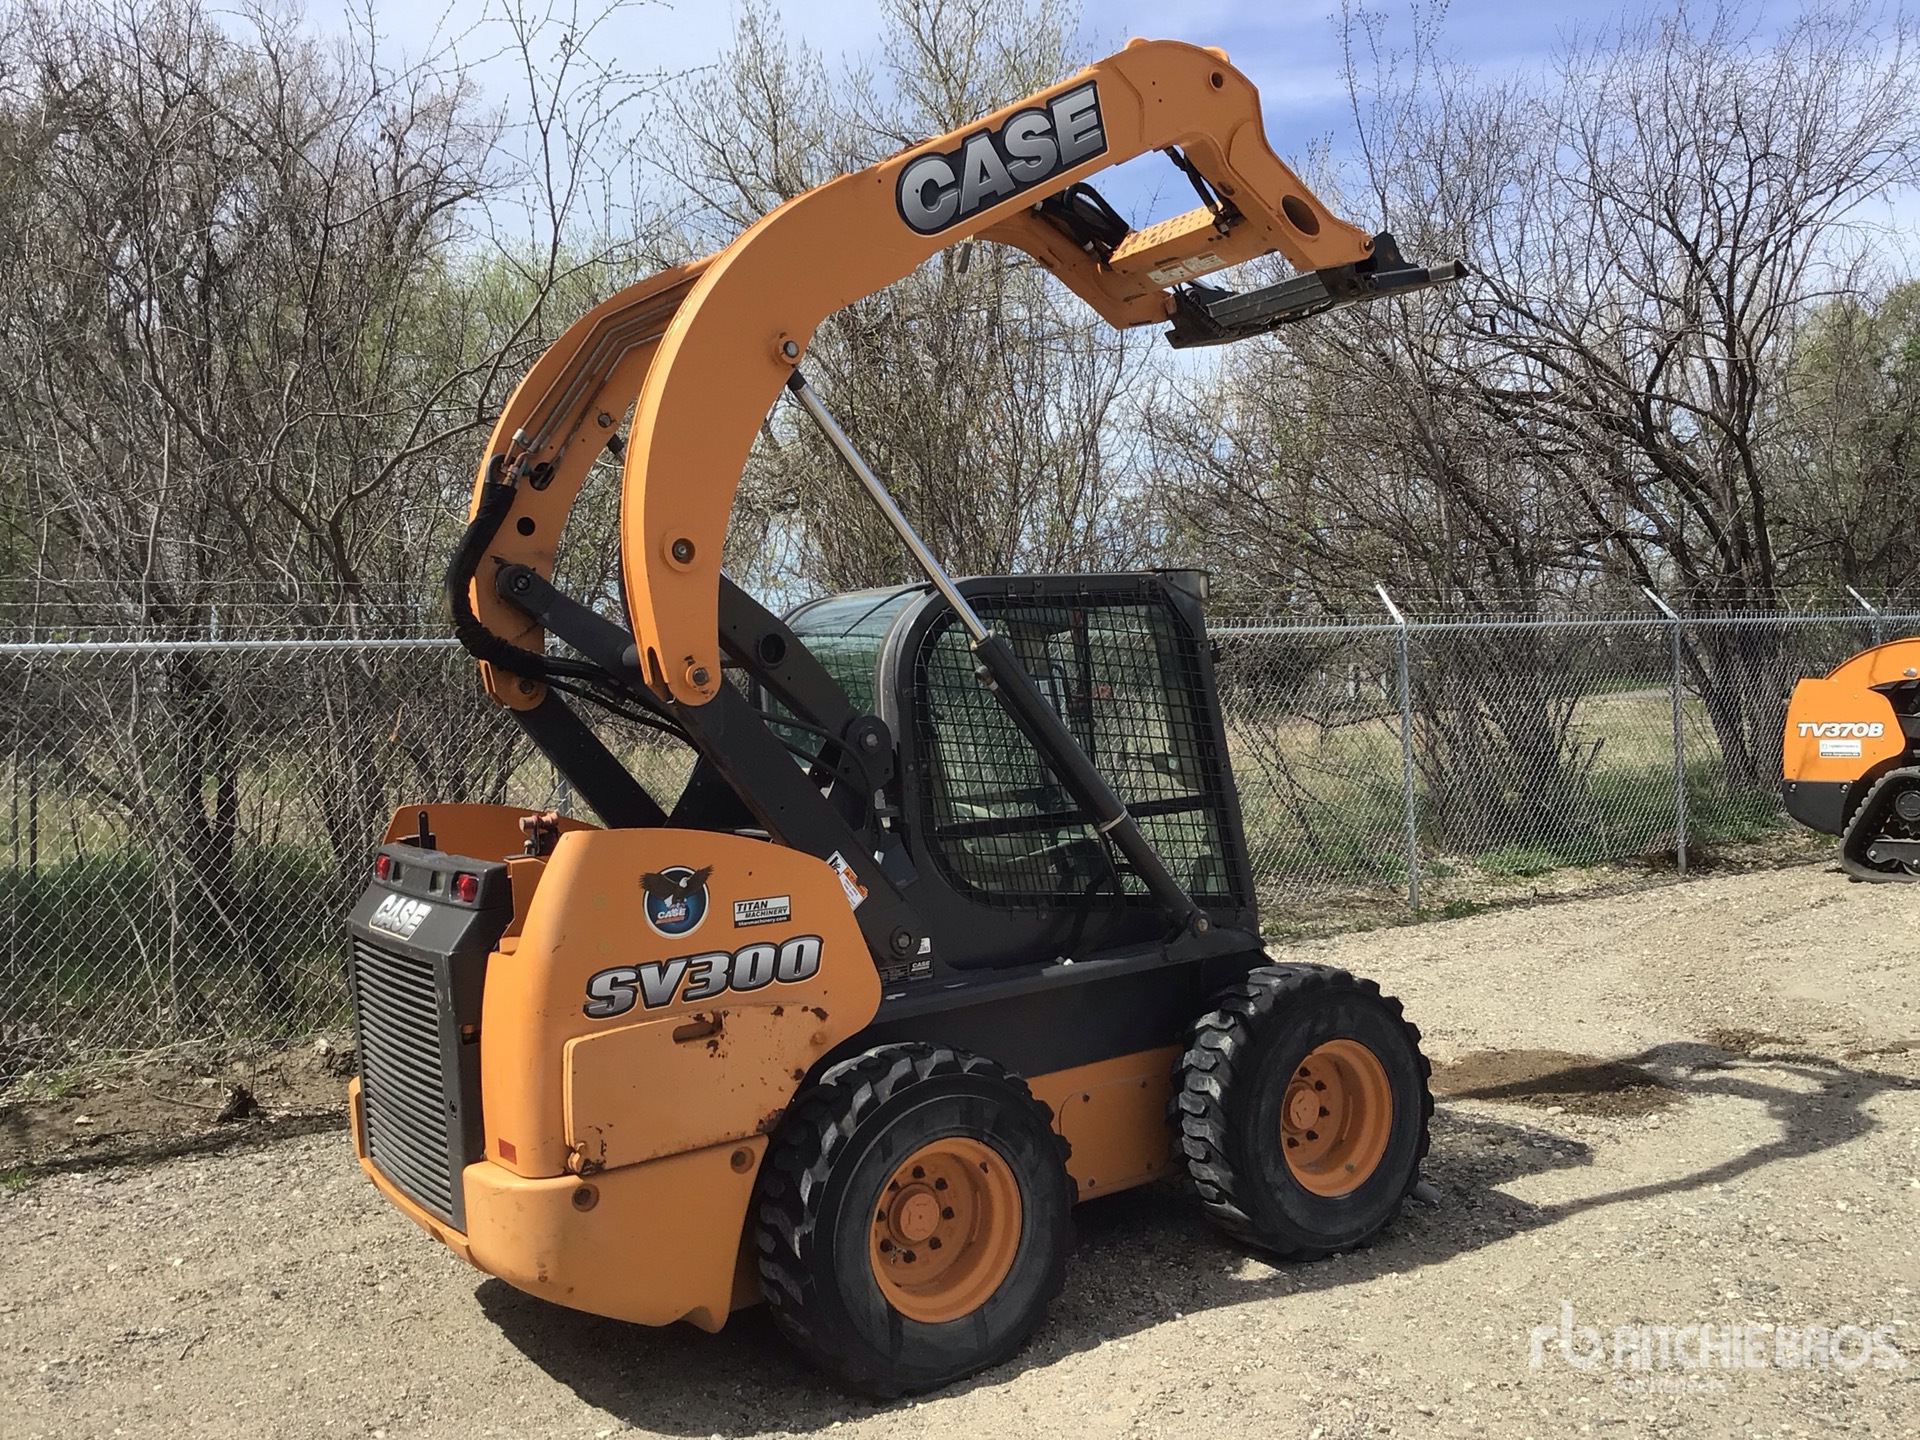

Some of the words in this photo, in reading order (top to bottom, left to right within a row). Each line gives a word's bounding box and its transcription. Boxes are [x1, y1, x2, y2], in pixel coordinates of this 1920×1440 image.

[899, 84, 1106, 233] CASE
[1797, 722, 1885, 738] TV370B
[657, 906, 686, 919] CASE
[737, 900, 769, 912] TITAN
[370, 892, 433, 937] CASE
[744, 908, 788, 919] MACHINERY
[911, 960, 931, 969] CASE
[584, 935, 823, 1018] SV300
